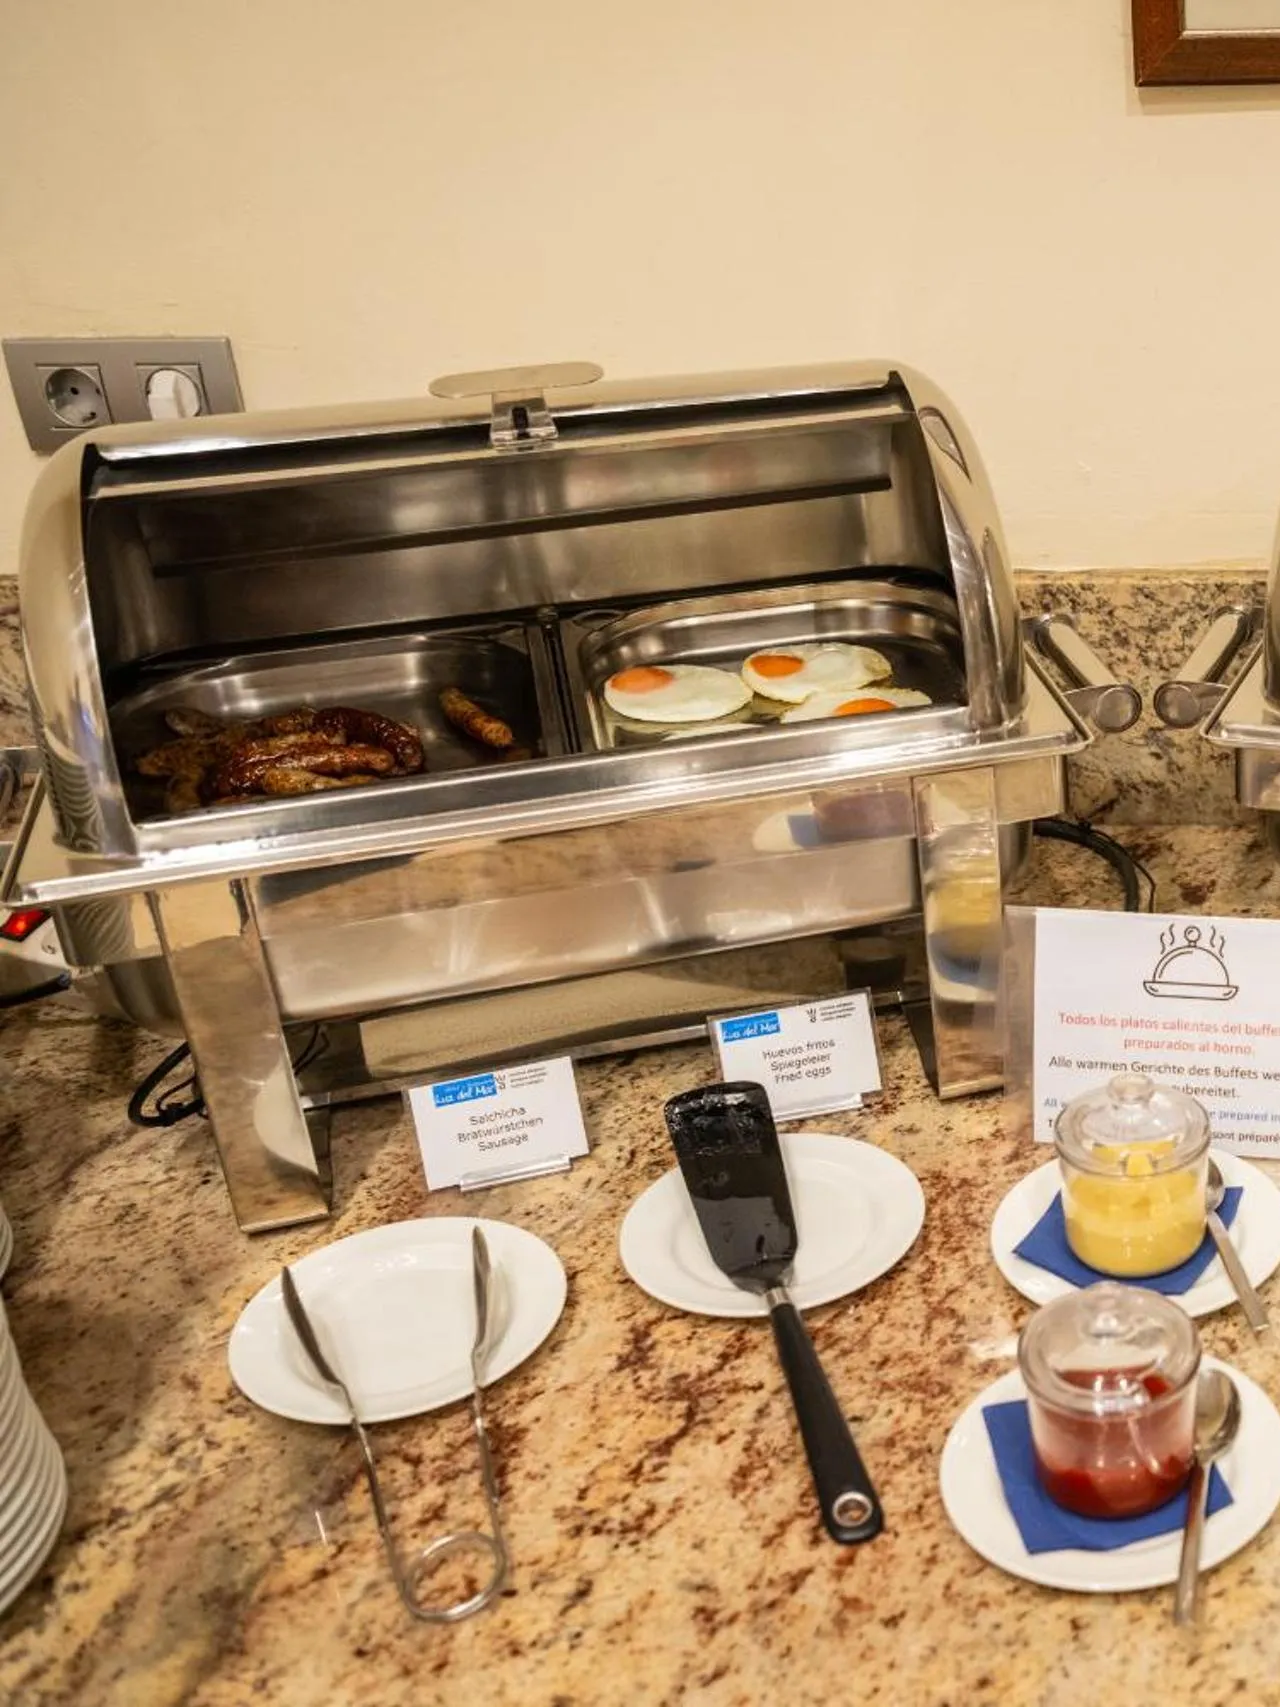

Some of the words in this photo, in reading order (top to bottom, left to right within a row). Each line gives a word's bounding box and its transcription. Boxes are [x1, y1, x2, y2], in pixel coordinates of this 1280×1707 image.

[1059, 1013, 1096, 1026] Todos
[1100, 1014, 1117, 1026] los
[1120, 1015, 1159, 1030] platos
[1162, 1018, 1218, 1033] calientes
[1222, 1021, 1241, 1034] del
[806, 1039, 836, 1052] fritos
[1123, 1037, 1196, 1051] preparados
[1198, 1040, 1210, 1052] al
[771, 1053, 832, 1072] Spiegeleier
[1048, 1056, 1073, 1068] Alle
[1076, 1059, 1127, 1071] warmen
[1131, 1061, 1185, 1075] Gerichte
[1188, 1065, 1211, 1076] des
[1214, 1066, 1258, 1079] Buffets
[805, 1065, 832, 1081] eggs
[1044, 1098, 1058, 1107] All
[468, 1106, 527, 1126] Salchicha
[1219, 1109, 1268, 1122] prepared
[1271, 1111, 1280, 1121] in
[478, 1133, 529, 1152] Sausage
[1212, 1130, 1236, 1140] sont
